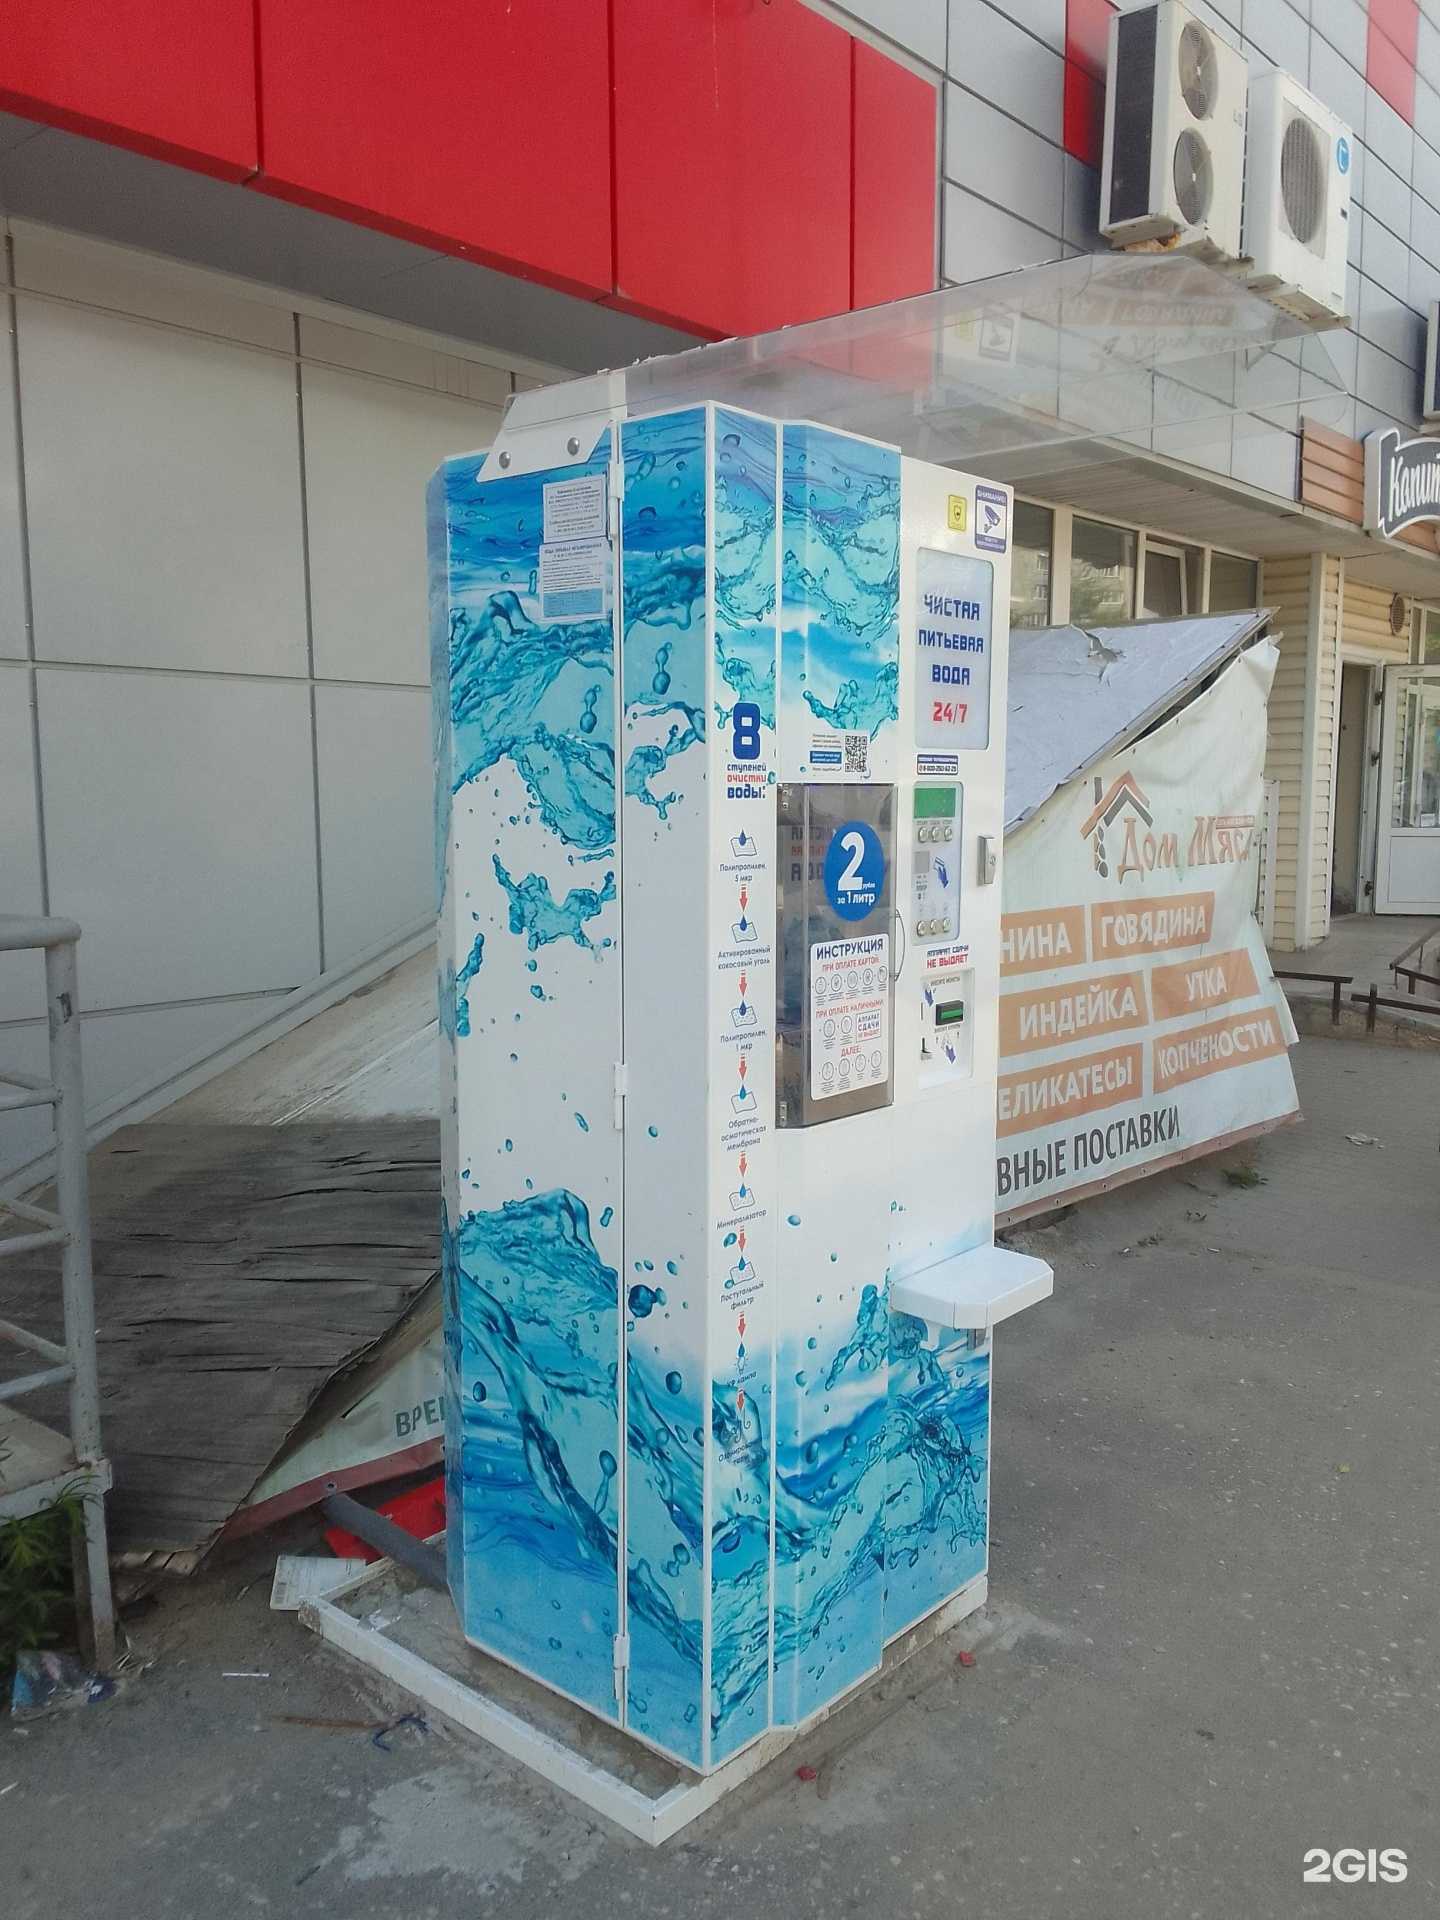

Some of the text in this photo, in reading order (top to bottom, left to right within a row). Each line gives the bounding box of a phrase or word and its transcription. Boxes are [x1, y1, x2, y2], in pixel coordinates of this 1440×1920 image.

[924, 594, 980, 621] ЧИСТАЯ
[918, 629, 984, 653] ПИТЬЕВАЯ
[932, 664, 970, 686] ВОДА
[933, 702, 968, 724] 24/7
[733, 703, 760, 760] 8
[727, 763, 767, 772] ступеней
[727, 774, 766, 784] очистки
[727, 784, 766, 799] воды:
[1117, 817, 1180, 885] Дом
[838, 832, 865, 891] 2
[847, 892, 851, 904] 1
[853, 893, 876, 906] литр
[1101, 904, 1206, 948] ГОВЯДИНА
[718, 945, 771, 959] Активированный
[816, 938, 884, 960] ИНСТРУКЦИЯ
[927, 945, 969, 957] АППАРАТ СДАЧИ
[718, 958, 752, 970] кокосовый
[822, 963, 834, 973] ПРИ
[835, 959, 856, 970] ОПЛАТЕ
[927, 954, 968, 968] НЕ ВЫДАЕТ
[1019, 966, 1228, 1041] ИНДЕЙКА УТКА
[816, 1009, 828, 1019] ПРИ
[829, 1005, 849, 1016] ОПЛАТЕ
[858, 1013, 880, 1022] АППАРАТ
[858, 1022, 880, 1031] СДАЧИ
[999, 1019, 1276, 1121] ЕЛИКАТЕСЫ КОПЧЕНОСТИ
[721, 1126, 766, 1141] осмотическая
[727, 1138, 760, 1151] мембрана
[997, 1105, 1180, 1197] ВНЫЕ ПОСТАВКИ
[717, 1209, 767, 1230] Минерализатор
[731, 1296, 754, 1311] фильтр
